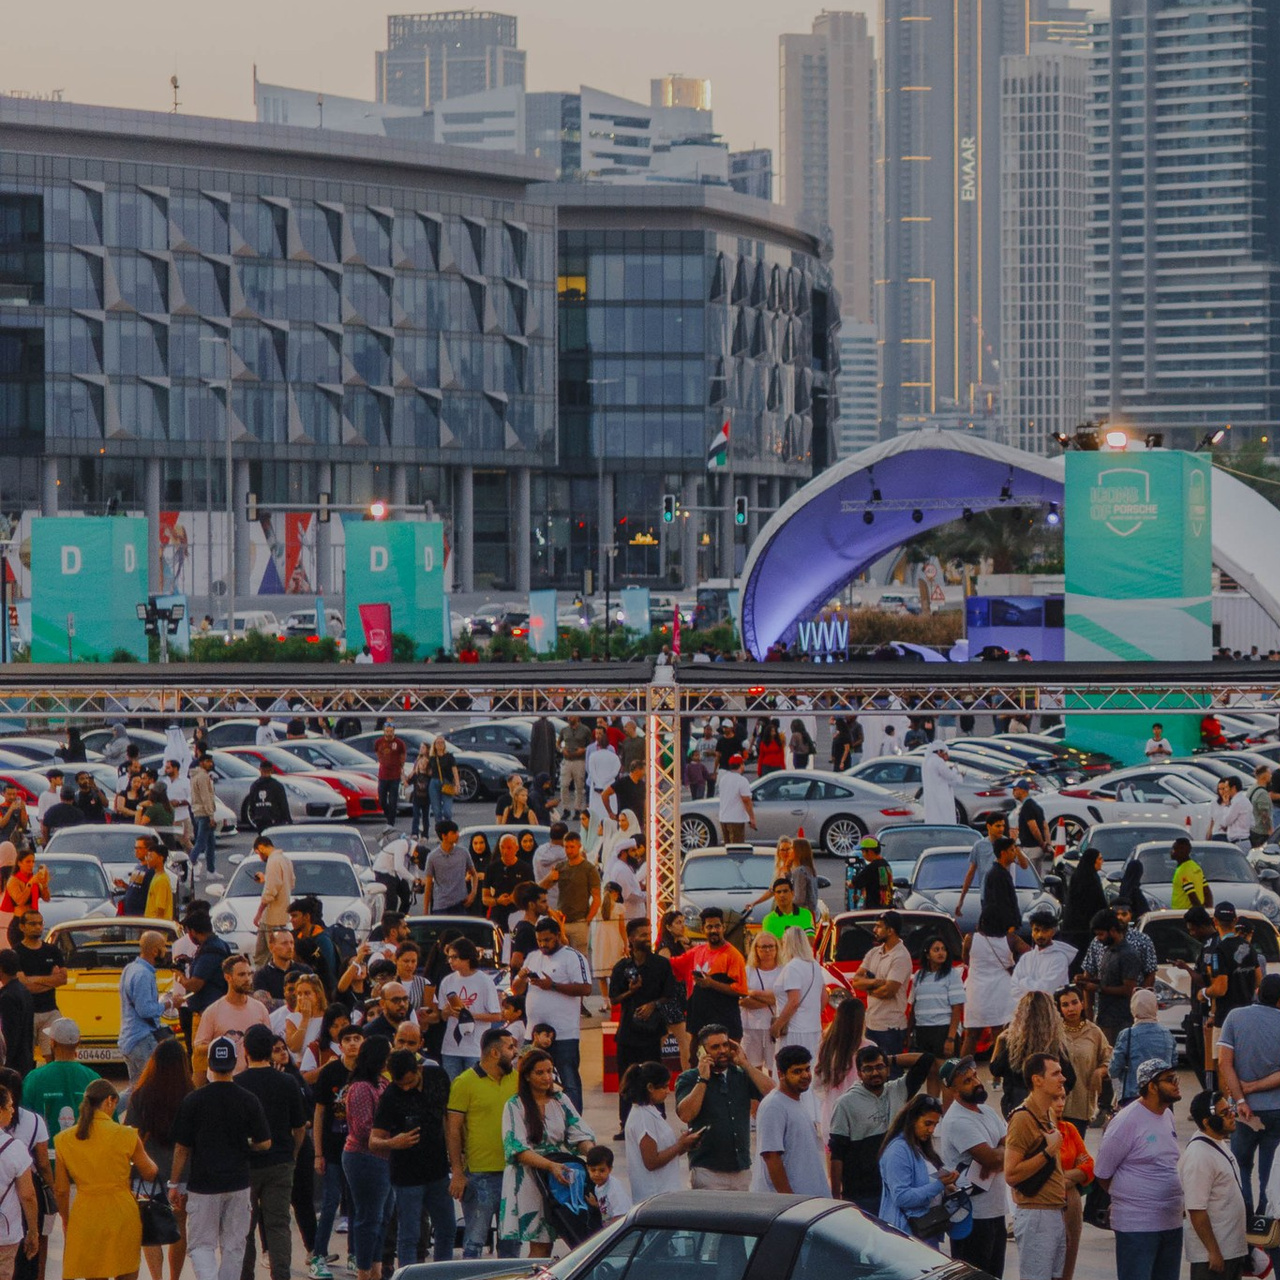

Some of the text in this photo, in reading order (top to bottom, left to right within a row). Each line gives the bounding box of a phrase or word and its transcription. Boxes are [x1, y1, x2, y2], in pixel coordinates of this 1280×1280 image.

[960, 135, 976, 201] EMAAR
[1113, 503, 1159, 515] PORSCHE
[60, 545, 82, 575] D
[123, 543, 136, 573] D
[369, 546, 389, 572] D
[424, 546, 434, 572] D
[77, 1049, 111, 1059] 604460
